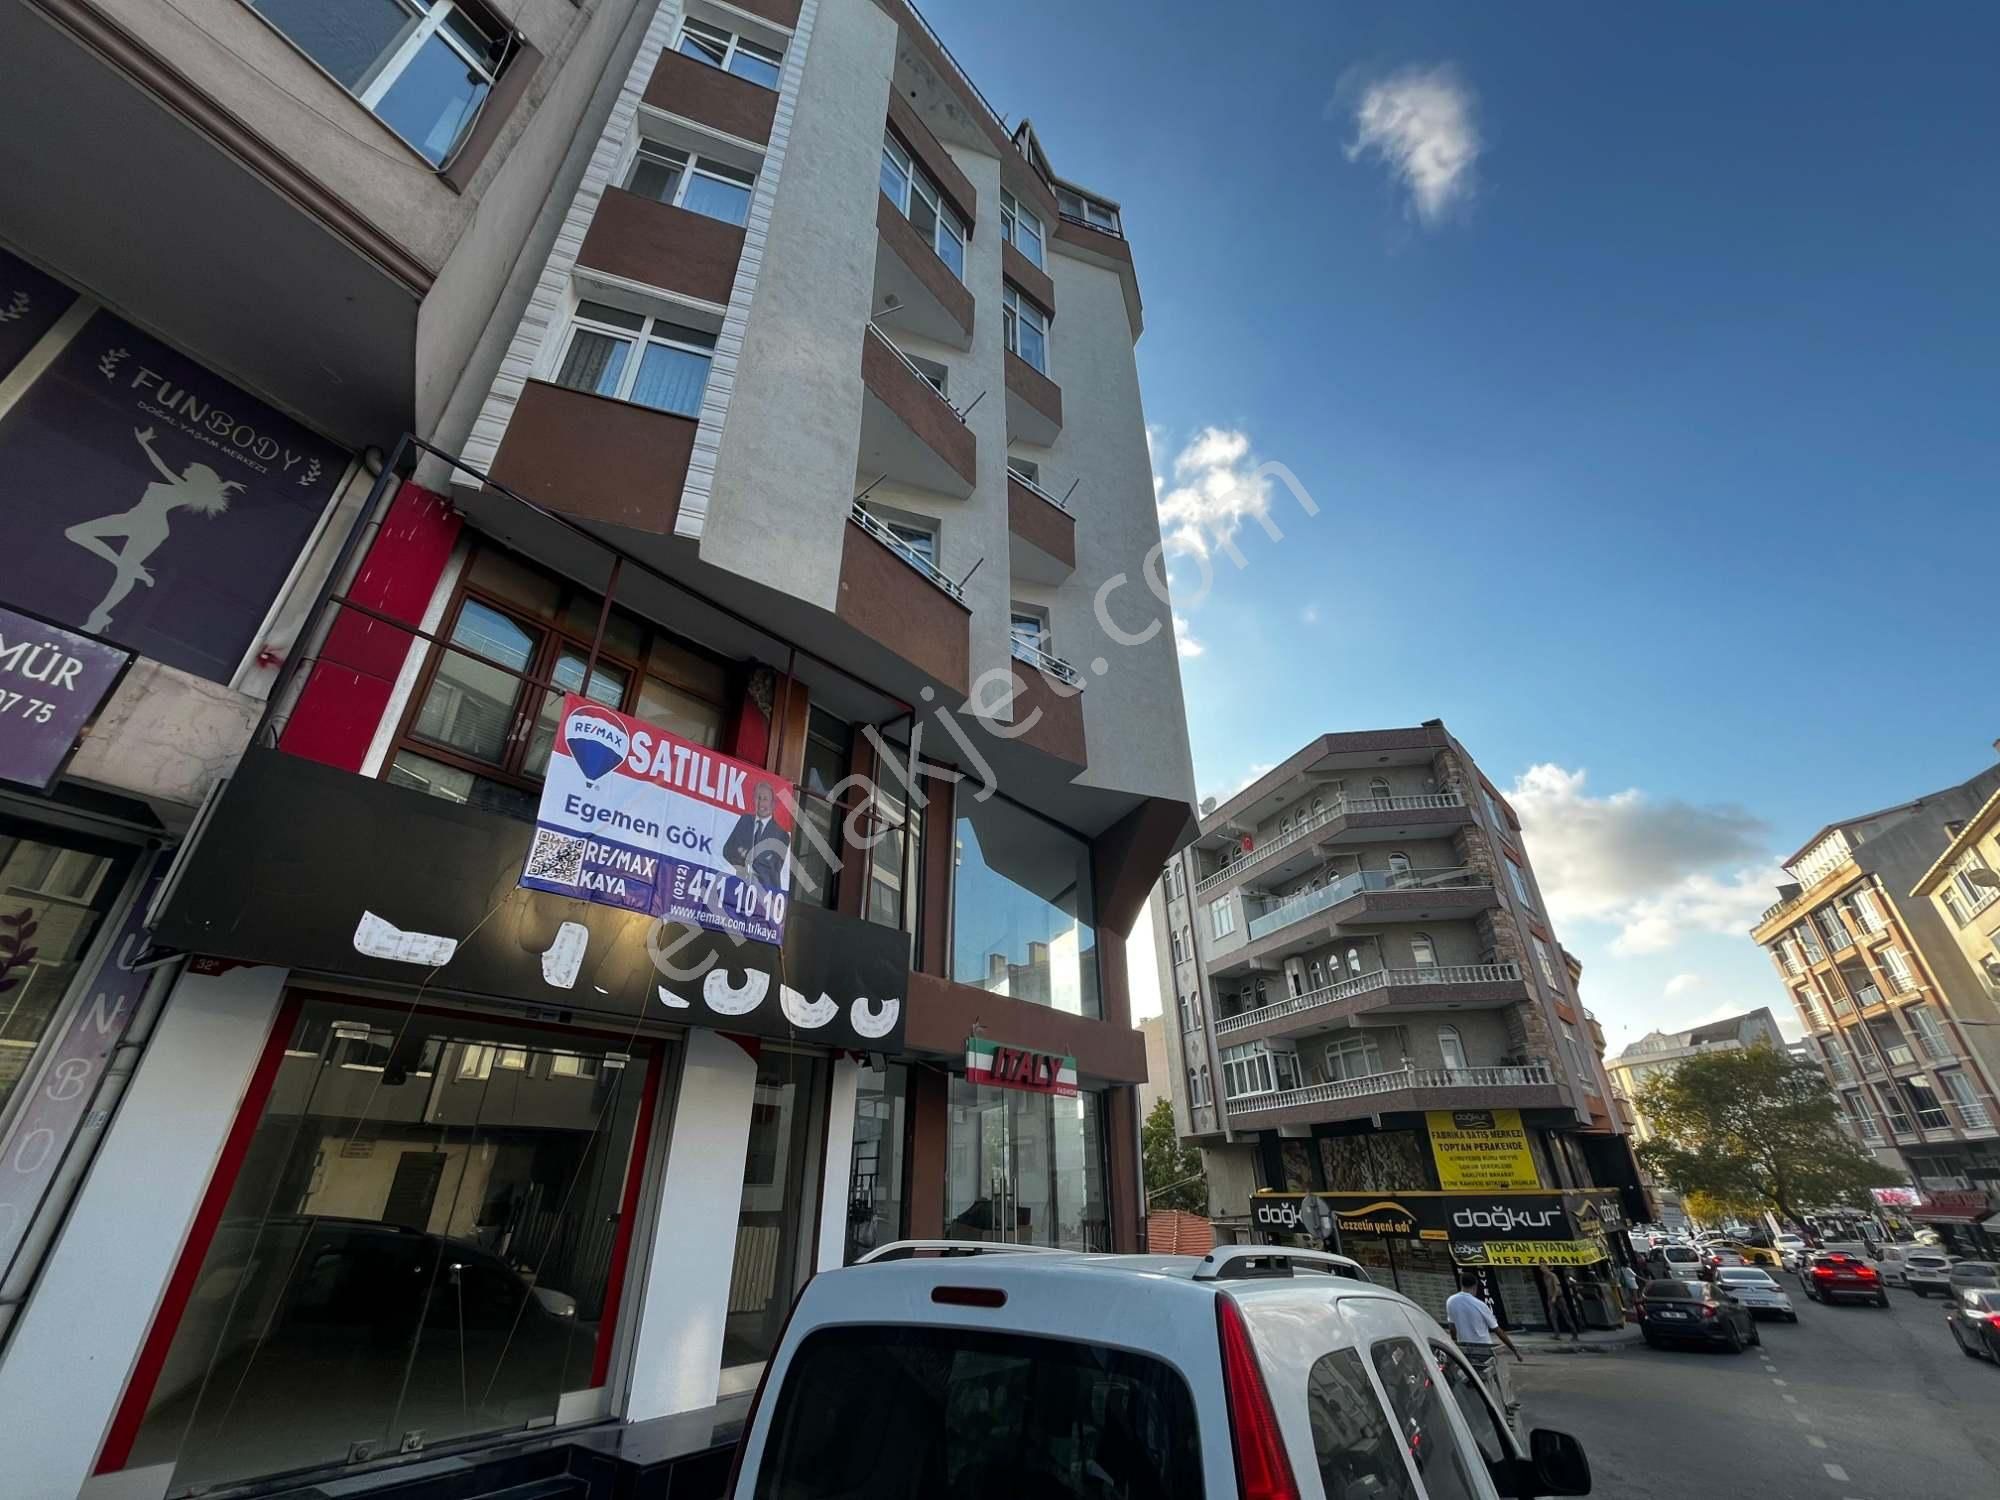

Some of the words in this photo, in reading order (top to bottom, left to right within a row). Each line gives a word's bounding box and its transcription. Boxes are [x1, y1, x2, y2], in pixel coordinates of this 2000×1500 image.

[131, 366, 302, 471] FUNBODY
[22, 698, 56, 723] 75
[575, 721, 623, 748] RE/MAX
[628, 731, 747, 810] SATILIK
[565, 794, 659, 838] Egemen
[667, 825, 712, 855] GÖK
[585, 841, 656, 878] RE/MAX
[579, 870, 626, 897] KAYA
[673, 864, 690, 900] (0212)
[688, 869, 727, 909] 471
[734, 881, 758, 917] 10
[763, 890, 785, 925] 10
[670, 904, 777, 940] www.remax.com.tr/kaya
[993, 1047, 1064, 1087] ITALY
[1438, 1143, 1472, 1152] TOPTAN
[1374, 1219, 1394, 1235] yeni
[1453, 1205, 1561, 1231] doğkur
[1486, 1242, 1531, 1252] TOPTAN
[1493, 1256, 1520, 1264] HER
[1526, 1255, 1580, 1264] ZAMAN
